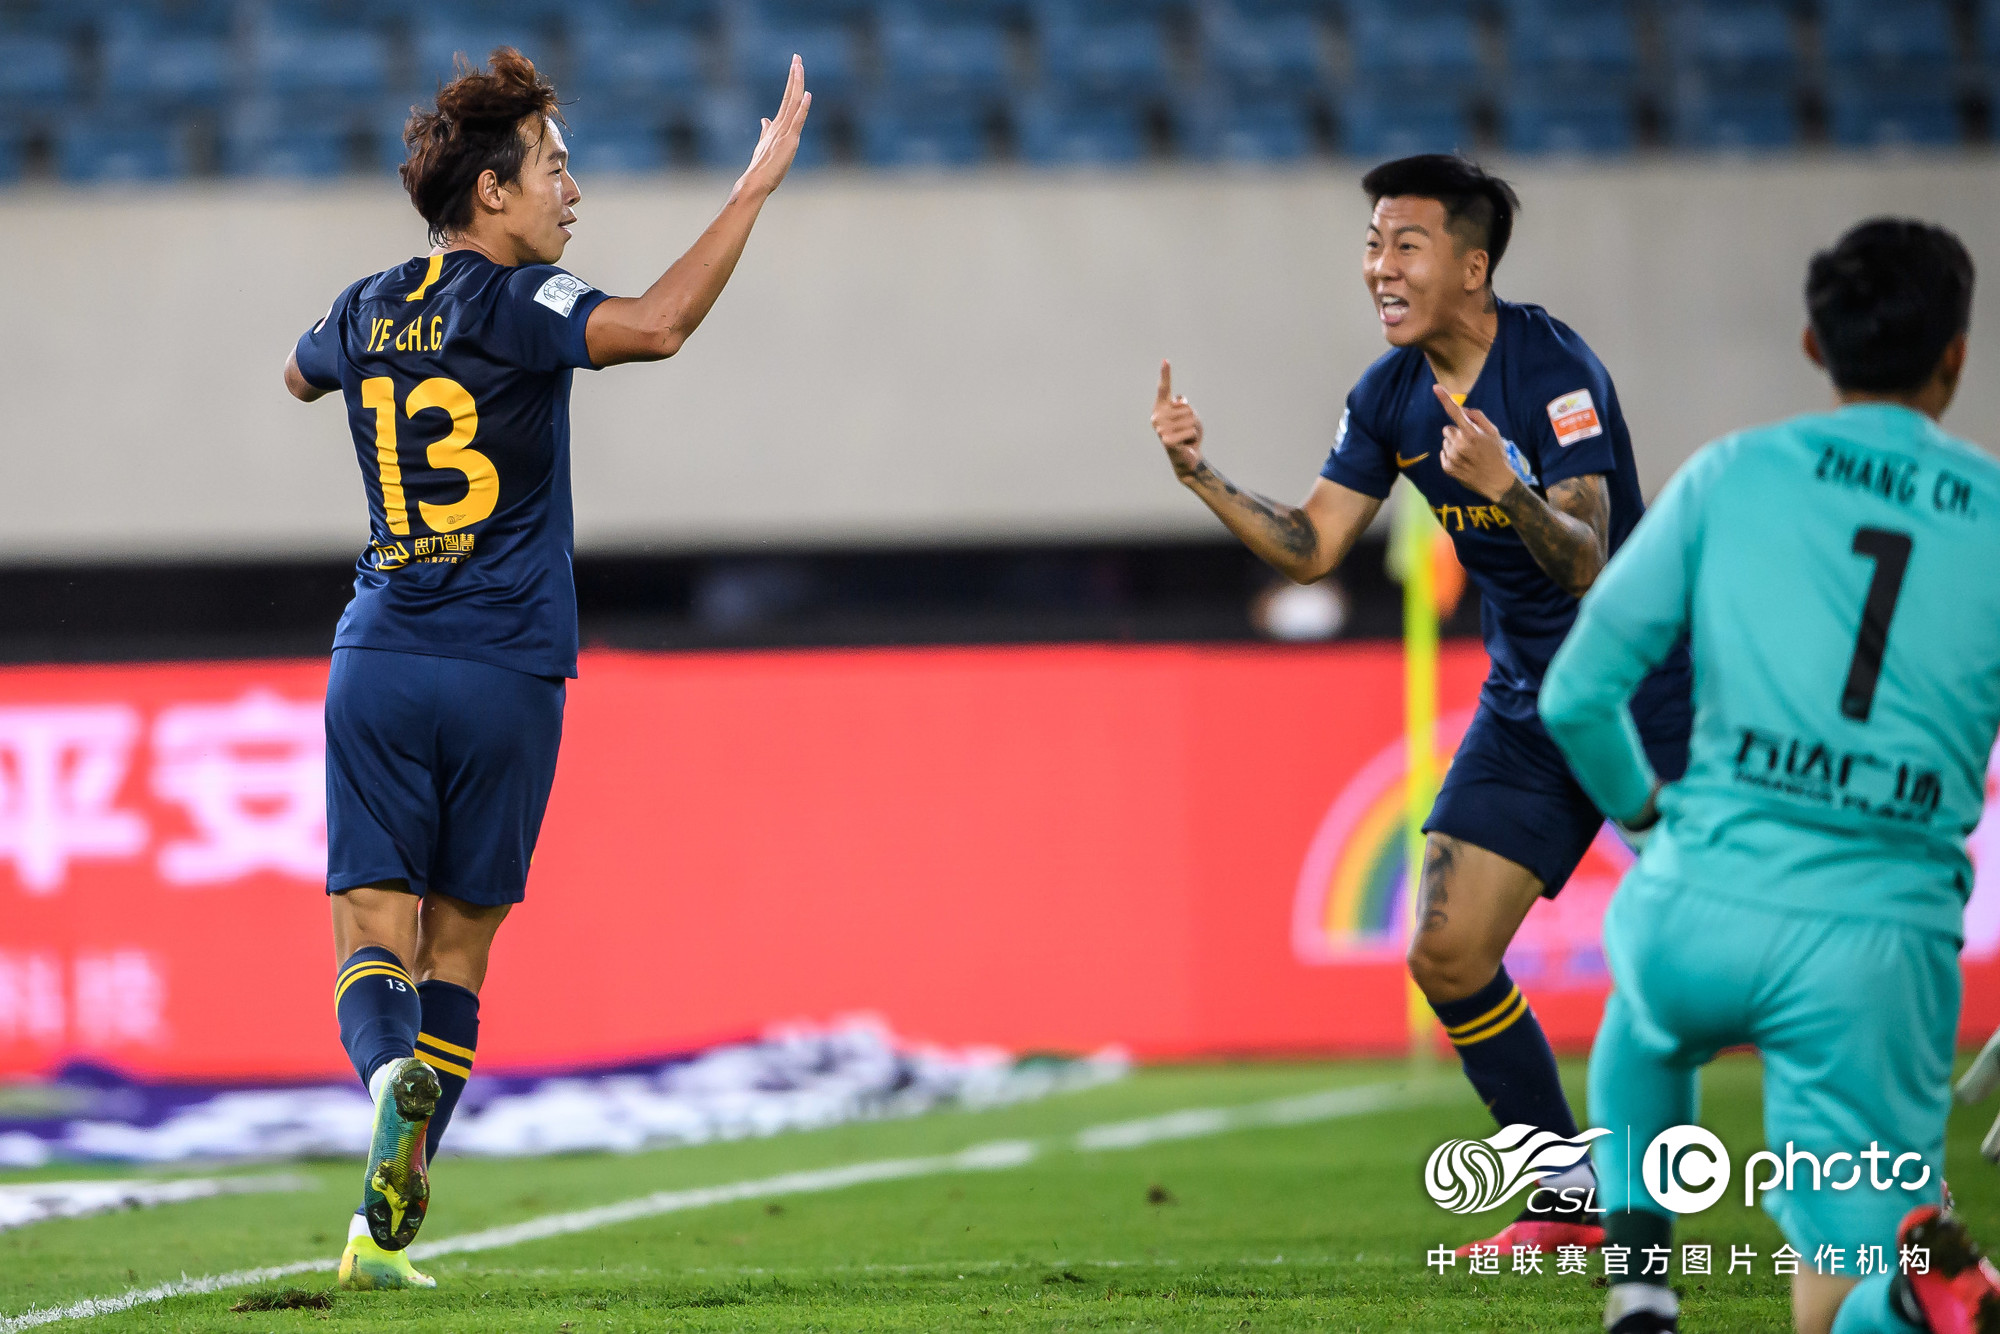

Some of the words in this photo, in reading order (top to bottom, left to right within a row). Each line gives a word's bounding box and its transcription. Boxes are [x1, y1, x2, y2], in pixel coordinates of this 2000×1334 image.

[366, 317, 394, 352] YE
[361, 376, 500, 534] 13
[1814, 443, 1919, 506] ZHANG
[414, 533, 475, 556] 思力智慧
[1841, 524, 1914, 724] 1
[0, 690, 327, 893] 平安
[385, 978, 407, 993] 13
